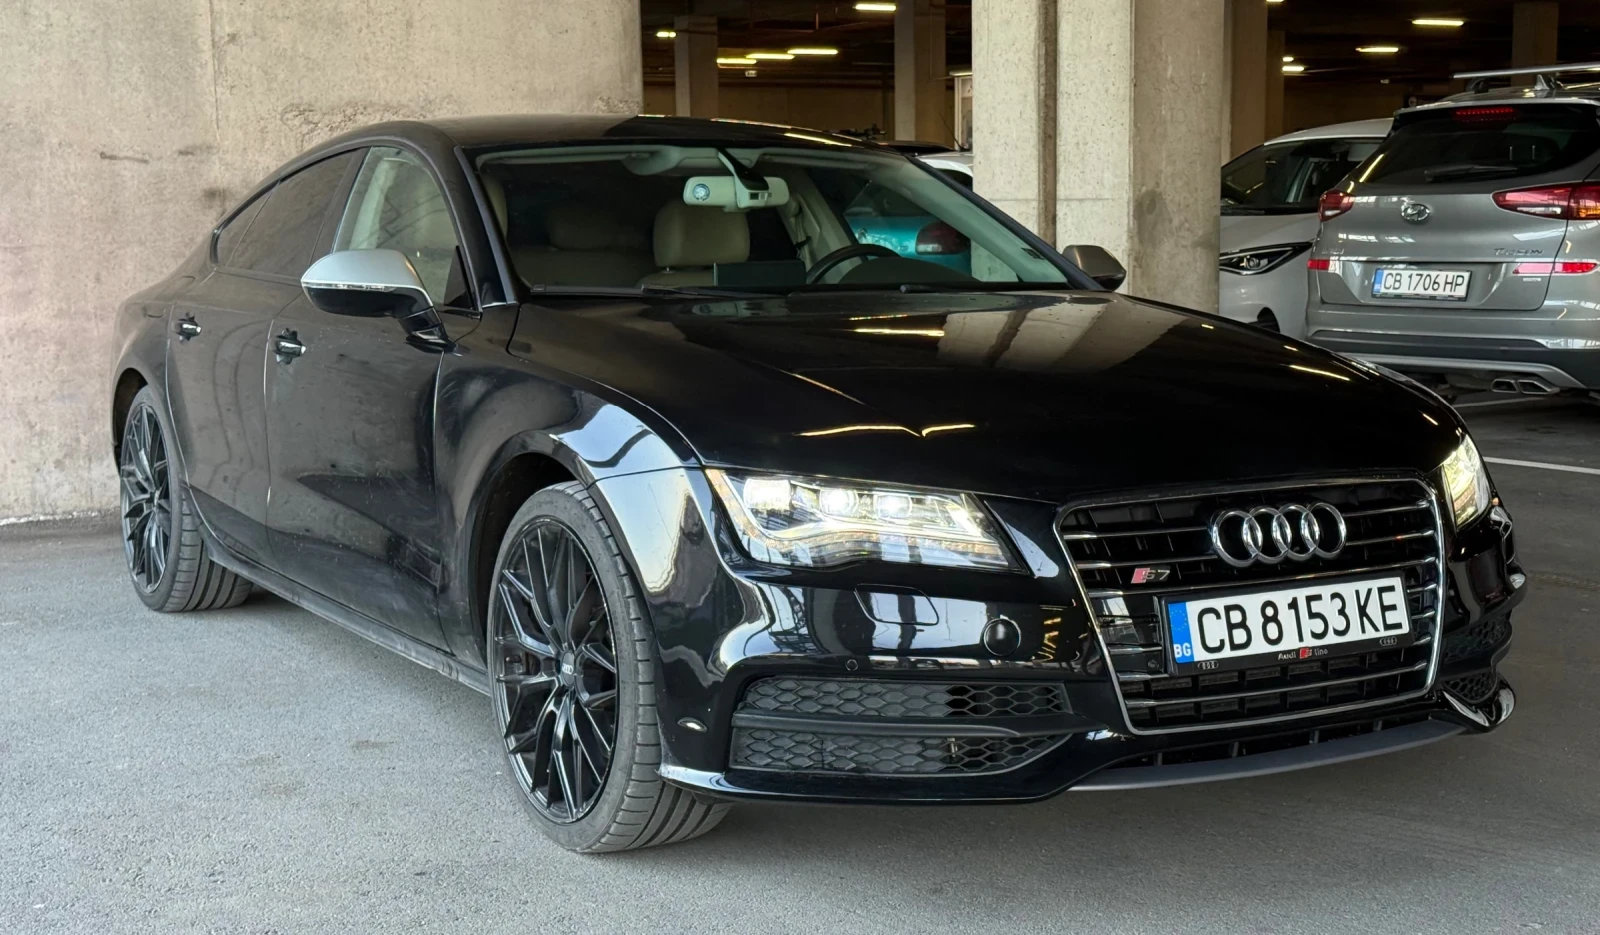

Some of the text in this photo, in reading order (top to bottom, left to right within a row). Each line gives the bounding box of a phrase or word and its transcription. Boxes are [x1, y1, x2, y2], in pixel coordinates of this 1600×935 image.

[1383, 272, 1403, 291] CB
[1407, 273, 1441, 291] 1706
[1443, 274, 1465, 293] HP
[1197, 585, 1403, 654] CB 8153 KE
[1173, 643, 1191, 658] BG
[1278, 651, 1297, 660] Audi
